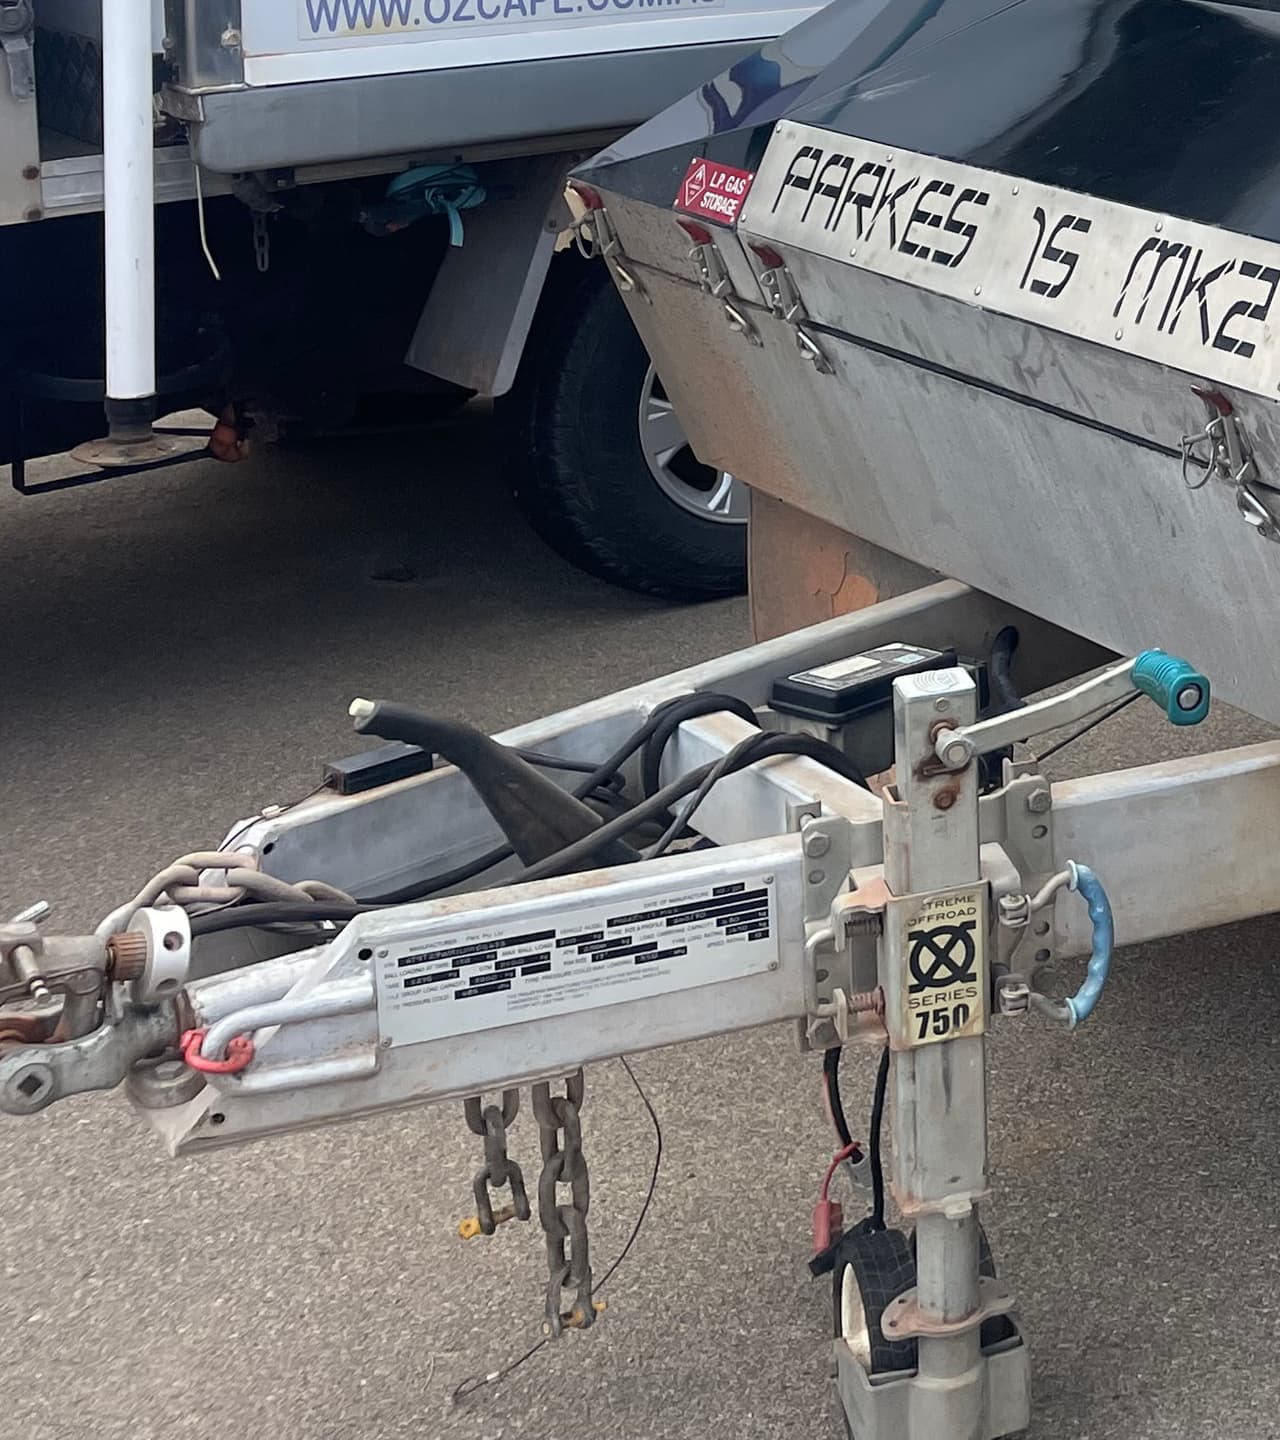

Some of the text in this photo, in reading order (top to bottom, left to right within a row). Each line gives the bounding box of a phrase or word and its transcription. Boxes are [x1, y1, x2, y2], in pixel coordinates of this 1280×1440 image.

[725, 175, 746, 195] GAS
[700, 191, 739, 216] STORAGE
[772, 146, 990, 268] PARKES
[1019, 206, 1092, 298] 15
[905, 907, 977, 927] OFFROAD
[909, 987, 977, 1009] SERIES
[915, 1003, 970, 1040] 750
